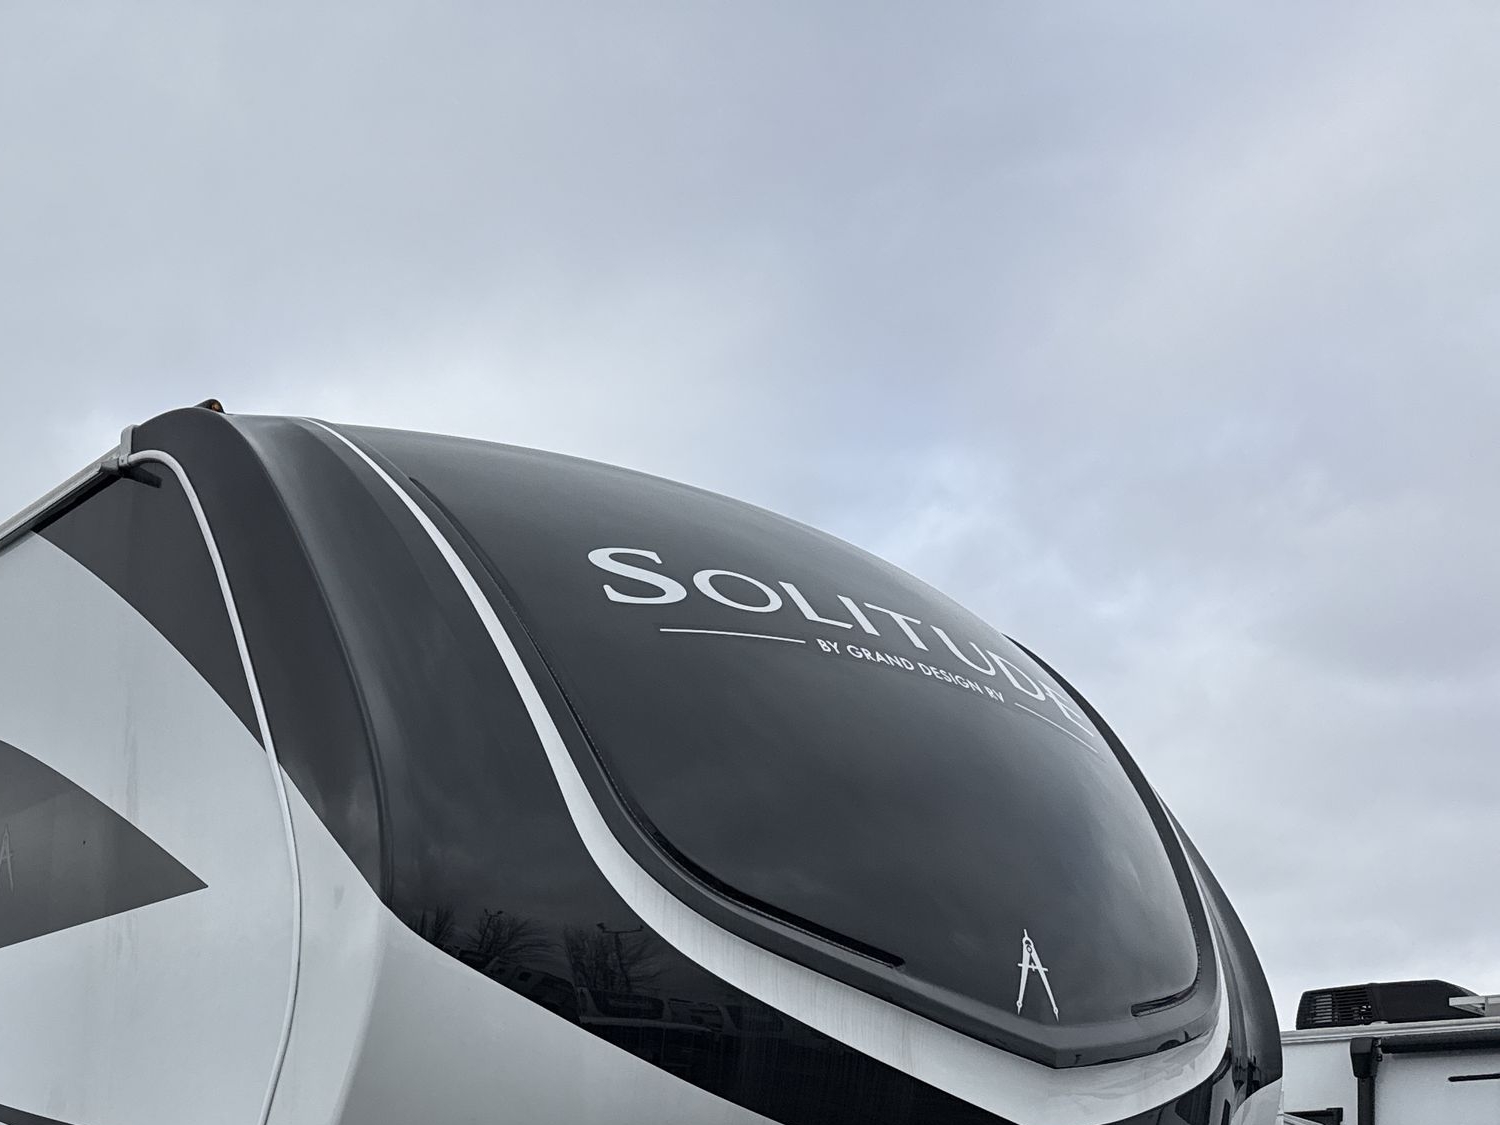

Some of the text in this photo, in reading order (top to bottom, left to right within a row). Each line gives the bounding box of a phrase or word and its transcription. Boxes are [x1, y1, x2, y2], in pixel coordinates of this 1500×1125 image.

[588, 547, 1095, 738] SOLITUDE
[815, 638, 1005, 704] BY GRAND DESIGN RV
